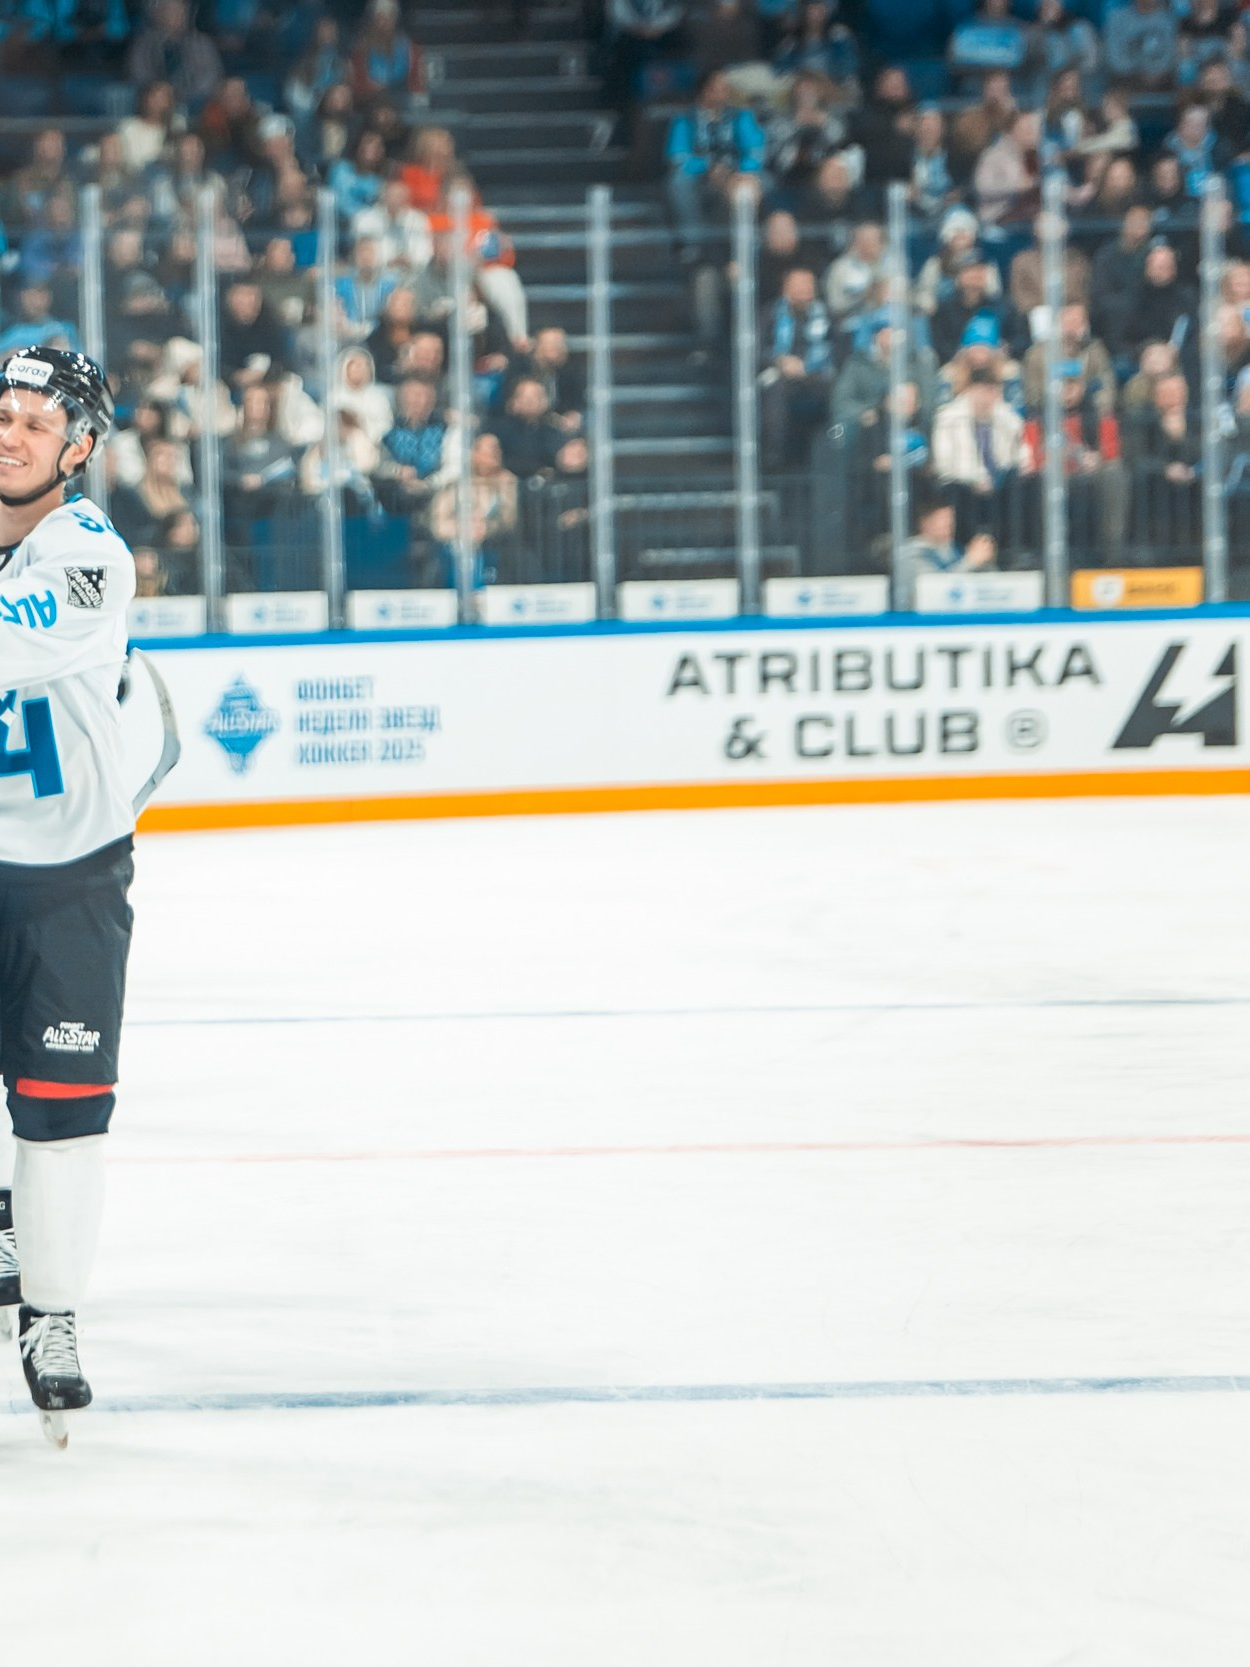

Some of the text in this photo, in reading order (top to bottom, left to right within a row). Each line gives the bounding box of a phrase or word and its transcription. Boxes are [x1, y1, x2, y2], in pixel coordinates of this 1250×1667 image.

[666, 640, 1102, 696] ATRIBUTIKA
[297, 705, 442, 735] НЕДЕЛЯ ЗВЕЗД
[723, 713, 766, 760] &
[794, 709, 980, 758] CLUB
[379, 737, 427, 762] 2025
